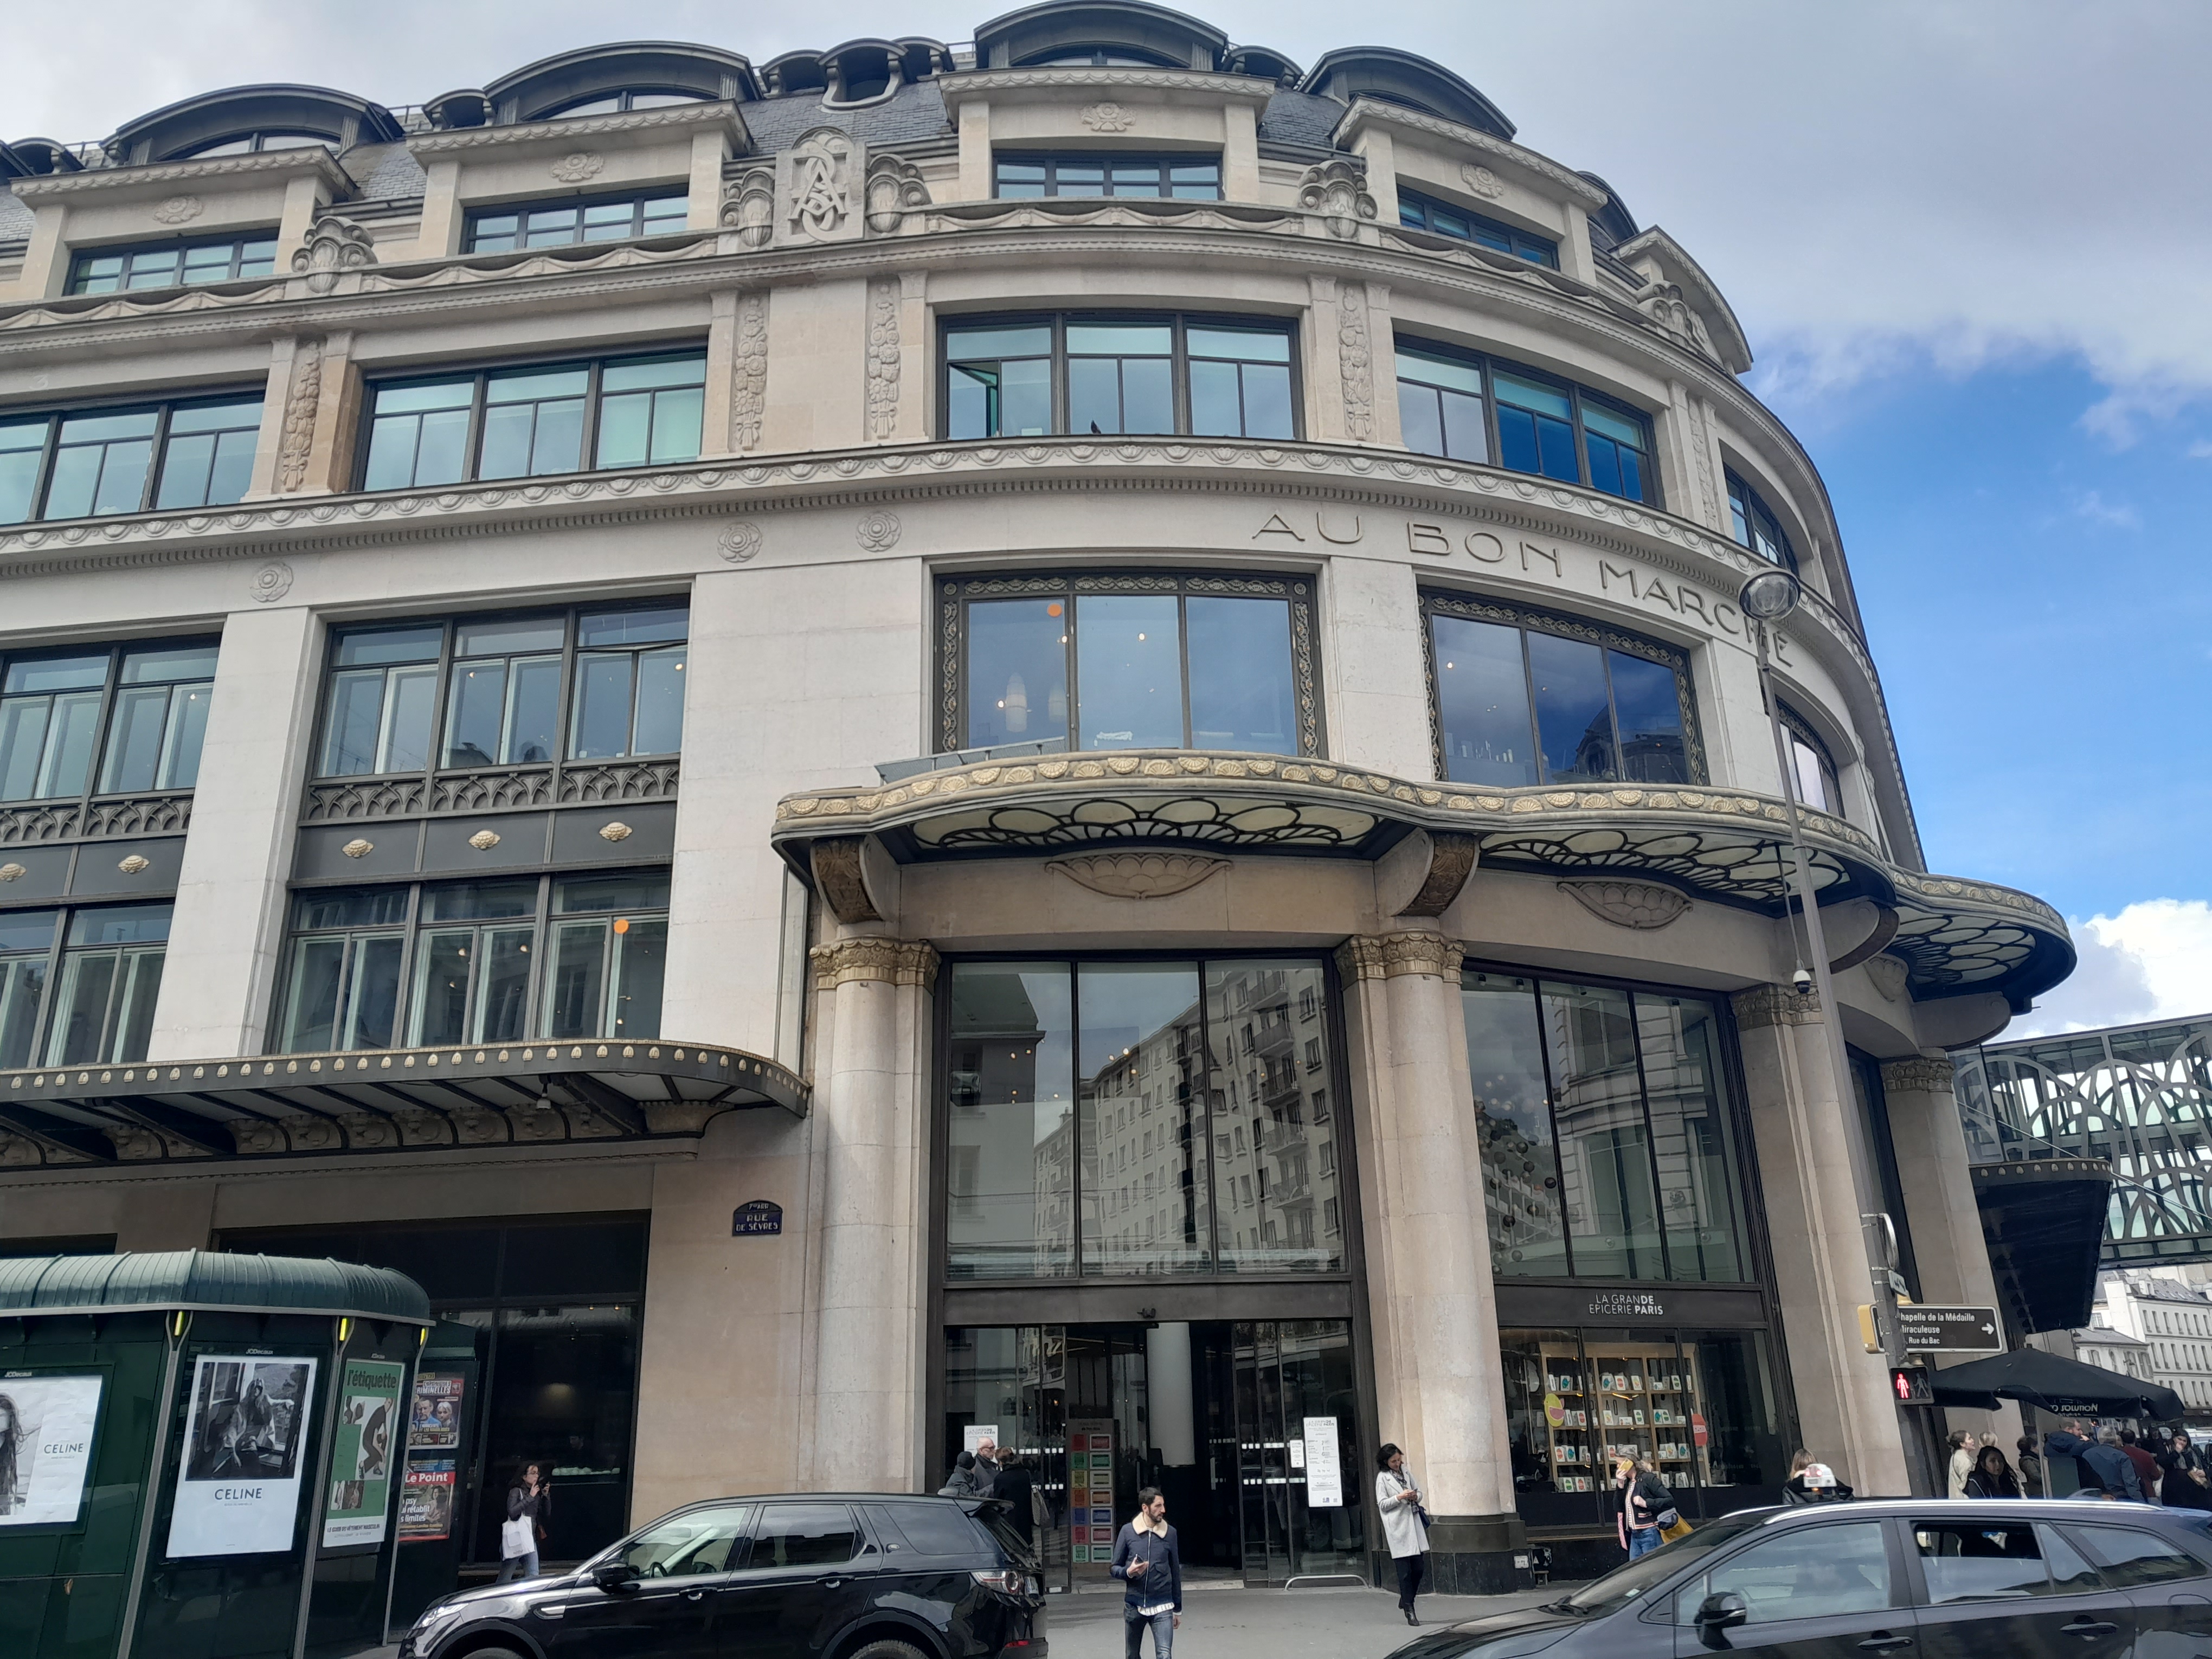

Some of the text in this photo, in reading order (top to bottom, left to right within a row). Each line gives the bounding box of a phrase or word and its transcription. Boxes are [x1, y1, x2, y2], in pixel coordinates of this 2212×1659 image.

[1251, 510, 1367, 545] AU
[1406, 521, 1562, 577] BON
[1596, 1294, 1655, 1304] LA GRANDE
[1589, 1304, 1663, 1315] EPICERIE PARIS
[1900, 1313, 1926, 1322] hapelle
[1938, 1313, 1944, 1321] la
[1945, 1313, 1975, 1322] Médaille
[346, 1369, 397, 1391] l'étiquette
[416, 1386, 451, 1395] RIMINELLES
[44, 1443, 84, 1454] CELINE
[405, 1471, 448, 1483] Le Point
[214, 1488, 262, 1500] CELINE
[406, 1497, 417, 1507] psy
[407, 1504, 430, 1514] rétablit
[404, 1514, 426, 1522] limites
